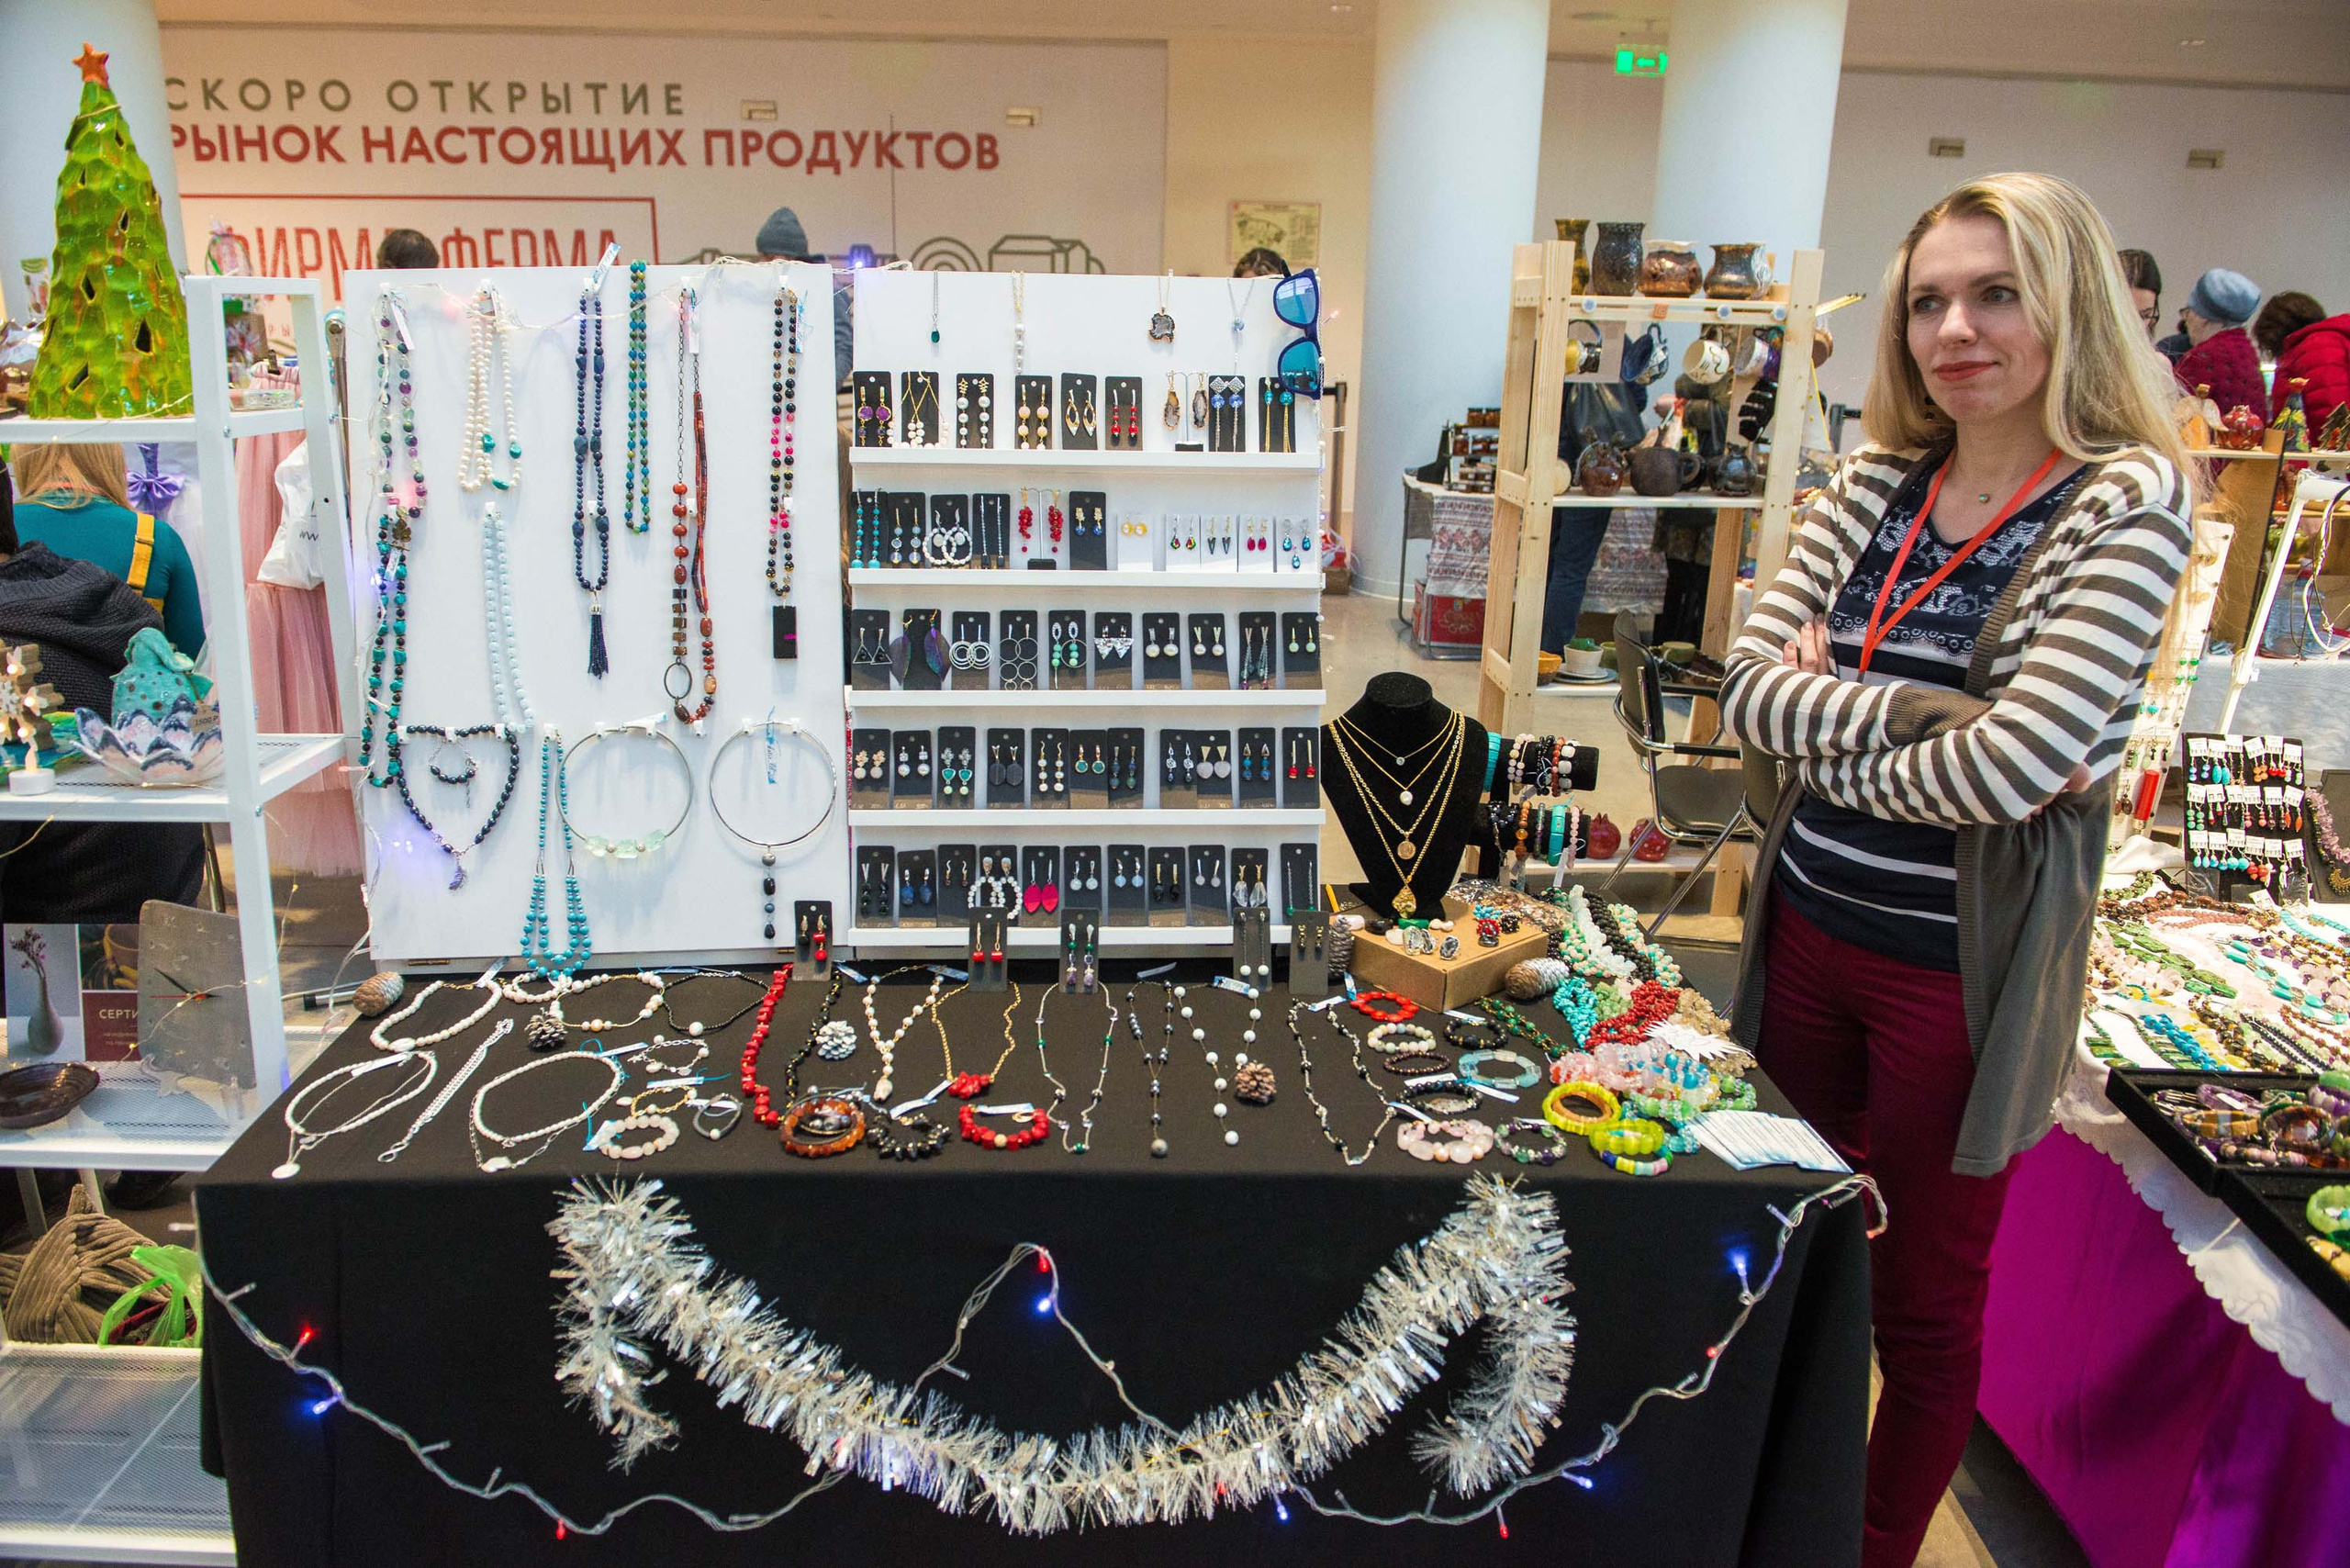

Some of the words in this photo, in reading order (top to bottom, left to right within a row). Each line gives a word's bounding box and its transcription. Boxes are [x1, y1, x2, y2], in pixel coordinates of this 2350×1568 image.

[164, 77, 352, 113] СКОРО
[386, 79, 684, 116] ОТКРЫТИЕ
[170, 123, 346, 163] РЫНОК
[362, 125, 687, 173] НАСТОЯЩИХ
[703, 129, 1001, 175] ПРОДУКТОВ
